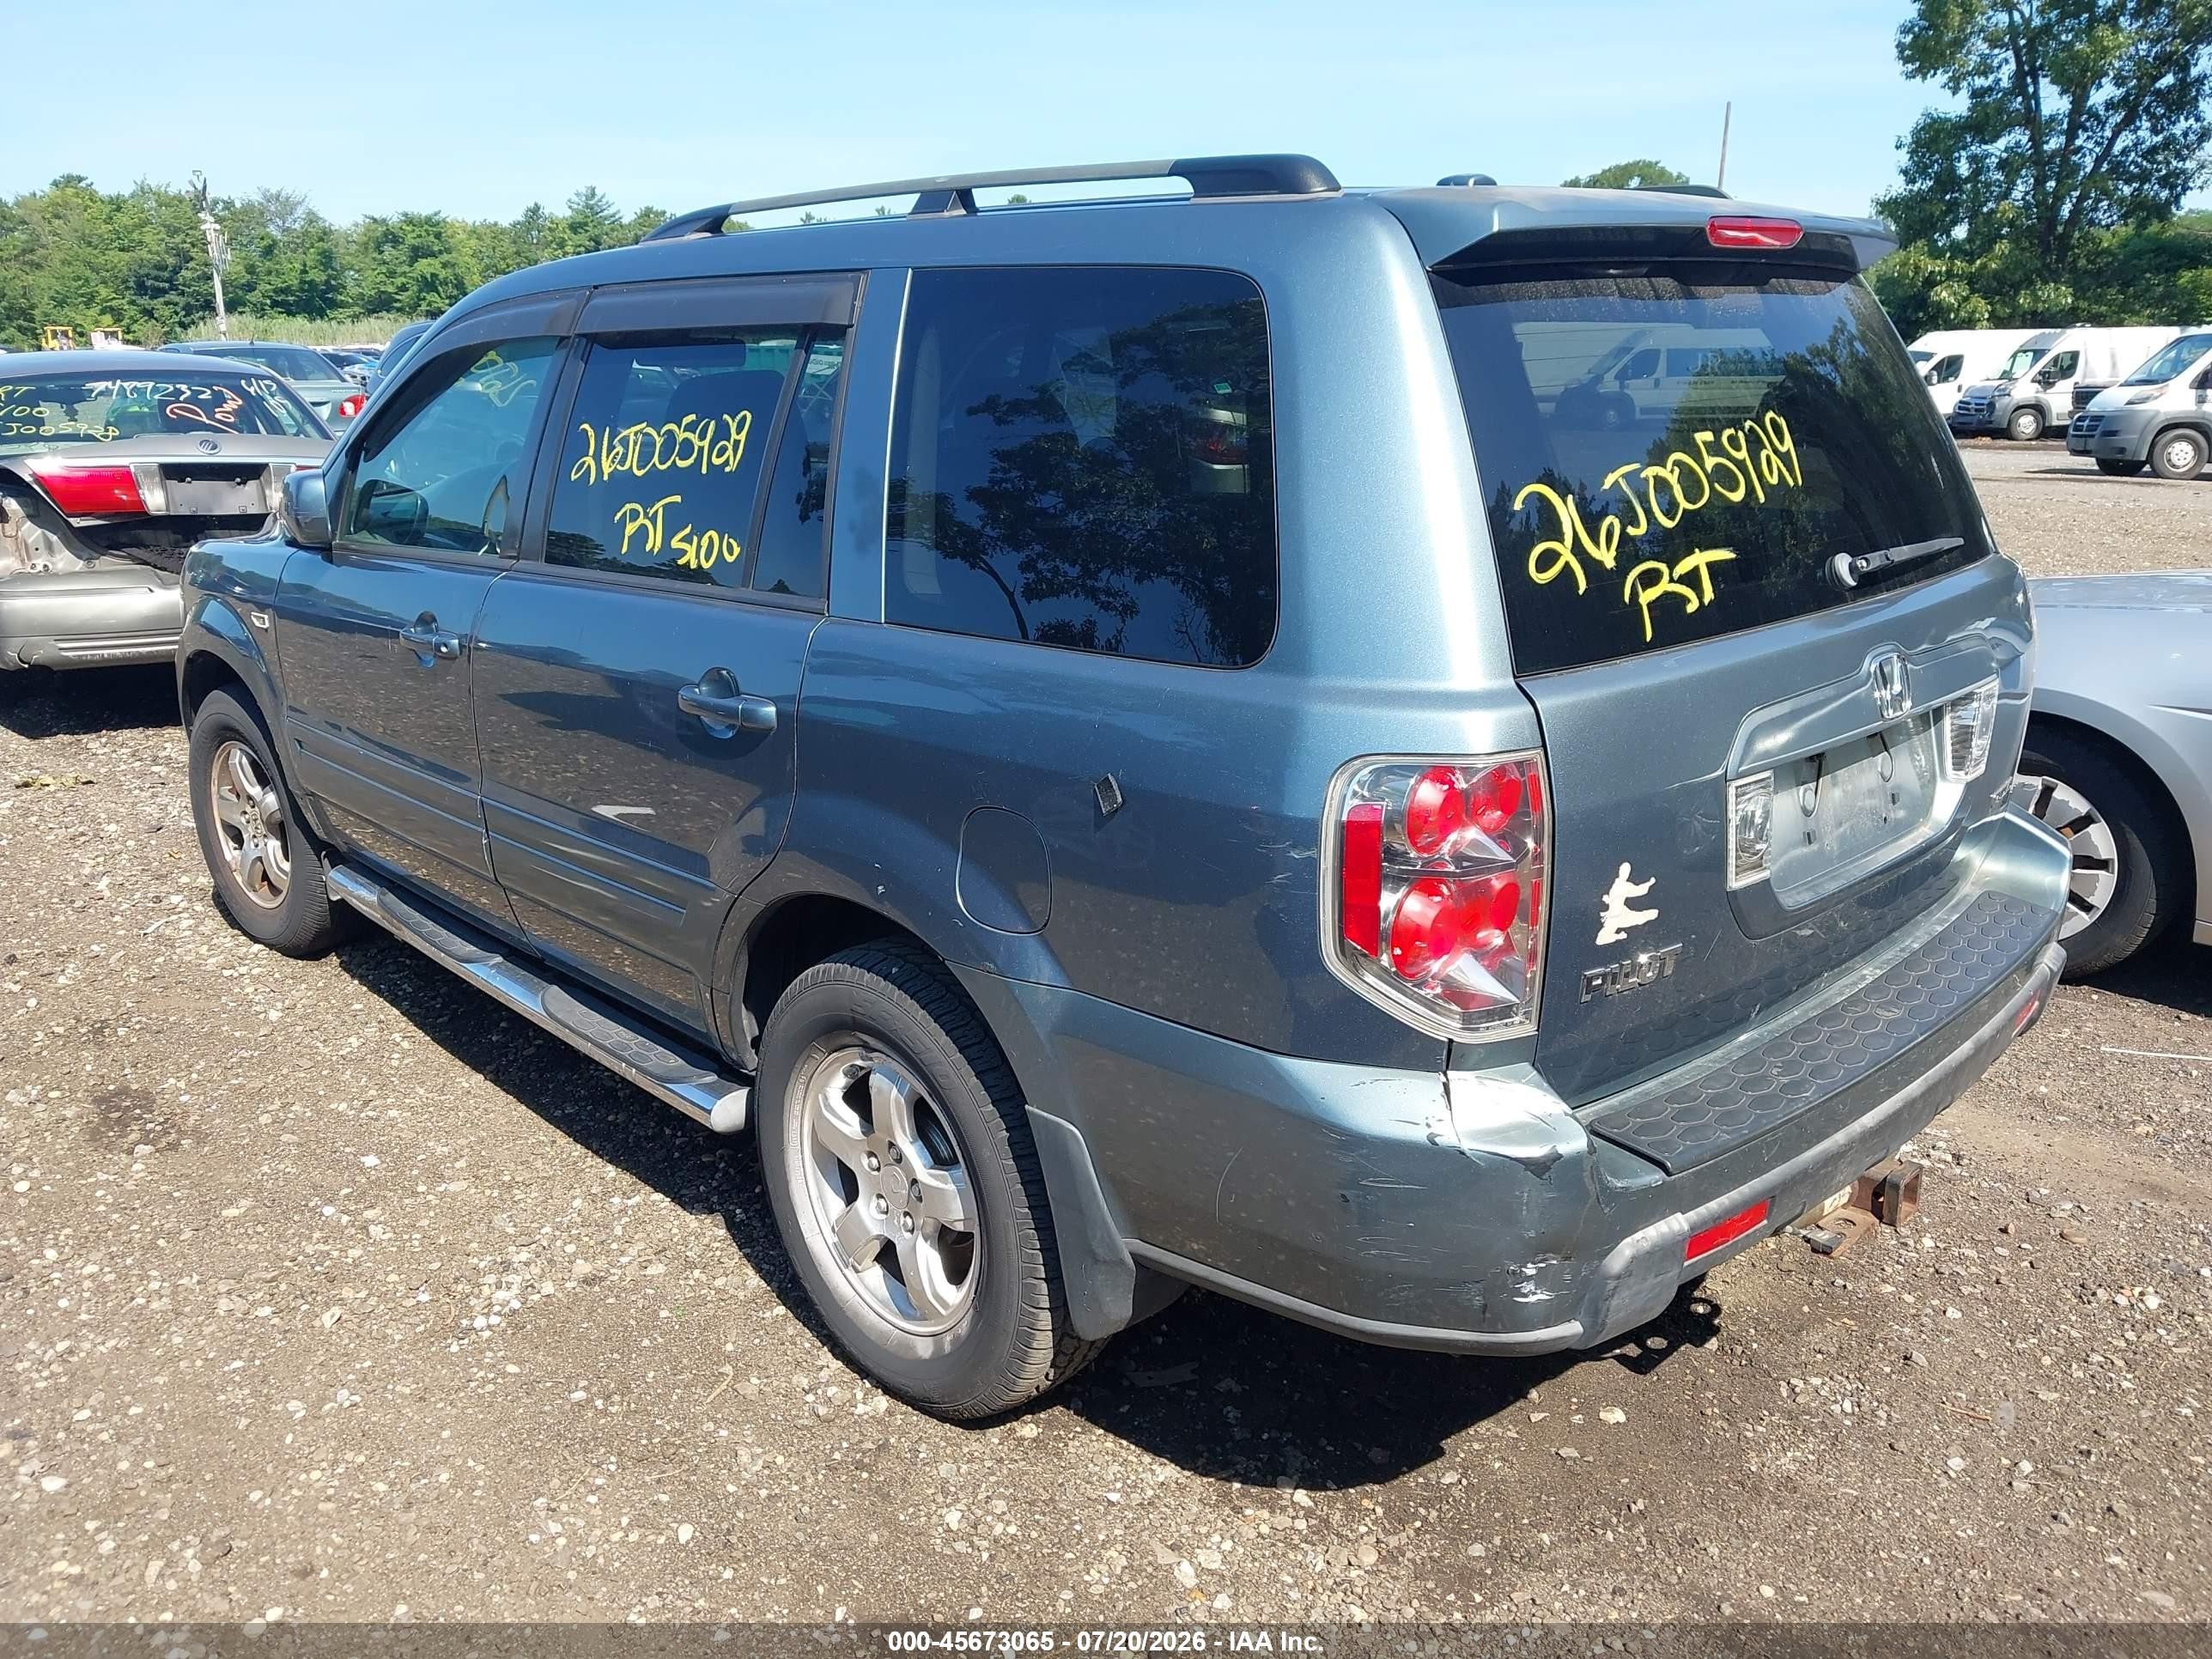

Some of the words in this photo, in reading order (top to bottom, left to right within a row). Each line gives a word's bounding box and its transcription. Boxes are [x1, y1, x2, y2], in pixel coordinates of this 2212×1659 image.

[613, 495, 682, 556] RT
[1513, 410, 1802, 595] 26J005929
[1624, 547, 1739, 642] RT
[1580, 943, 1683, 1005] PILOT
